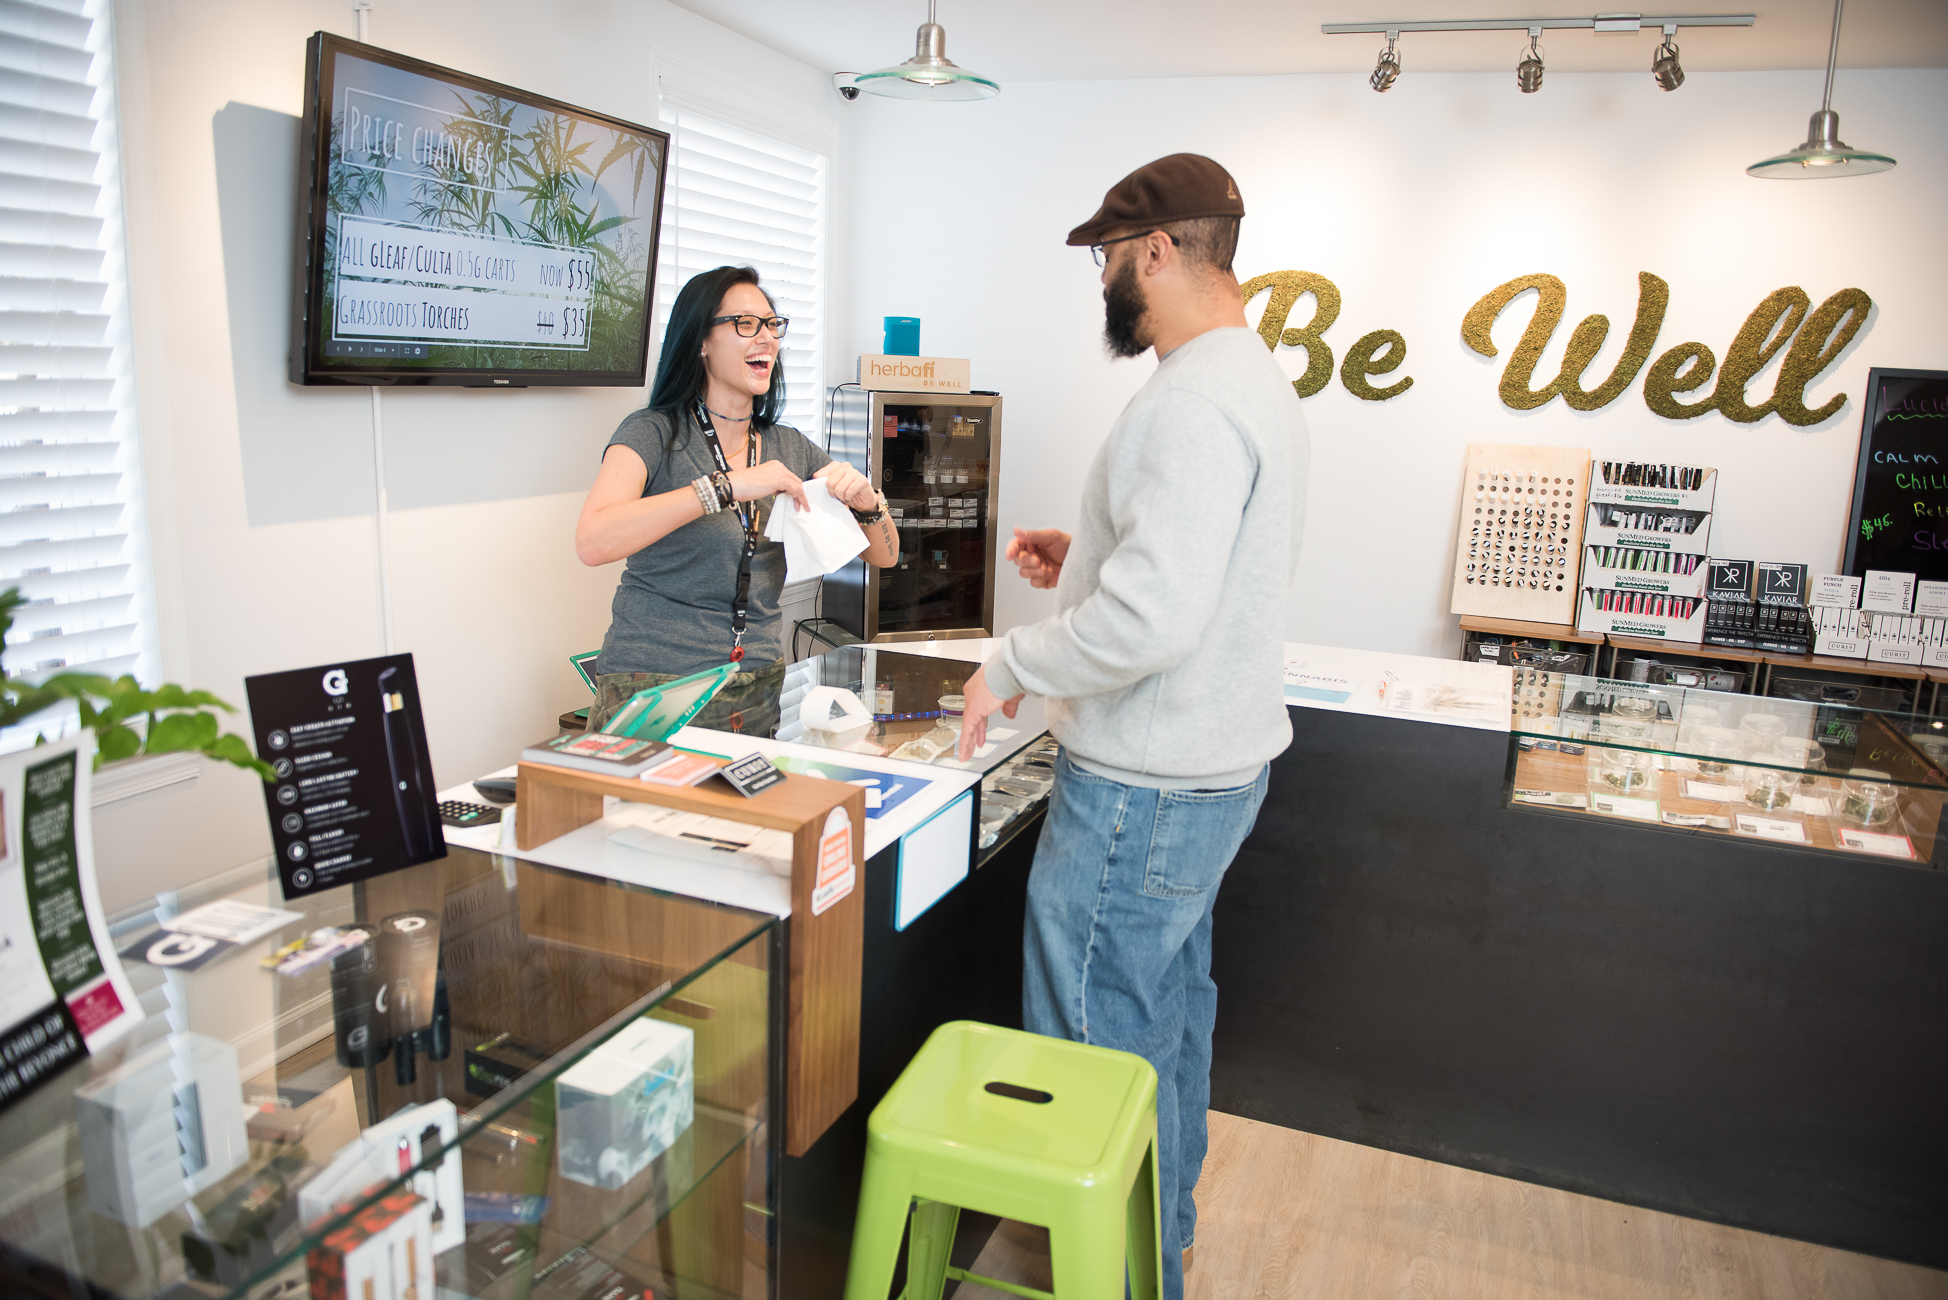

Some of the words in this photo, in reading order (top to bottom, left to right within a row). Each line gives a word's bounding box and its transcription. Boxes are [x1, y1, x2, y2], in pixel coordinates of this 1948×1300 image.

[350, 105, 404, 160] PRICE
[412, 127, 491, 178] CHANGES
[342, 236, 364, 267] ALL
[485, 256, 515, 282] CARTS
[540, 264, 564, 287] NOW
[568, 258, 591, 292] $55
[340, 295, 417, 328] GRASSROOTS
[422, 302, 469, 330] TORCHES
[562, 306, 585, 340] $35
[1242, 269, 1414, 401] Be
[1460, 271, 1872, 426] Well
[870, 359, 935, 378] herbafi
[1712, 590, 1745, 599] KAVIAR
[1764, 594, 1798, 603] KAVIAR
[1902, 581, 1912, 611] pre-roll
